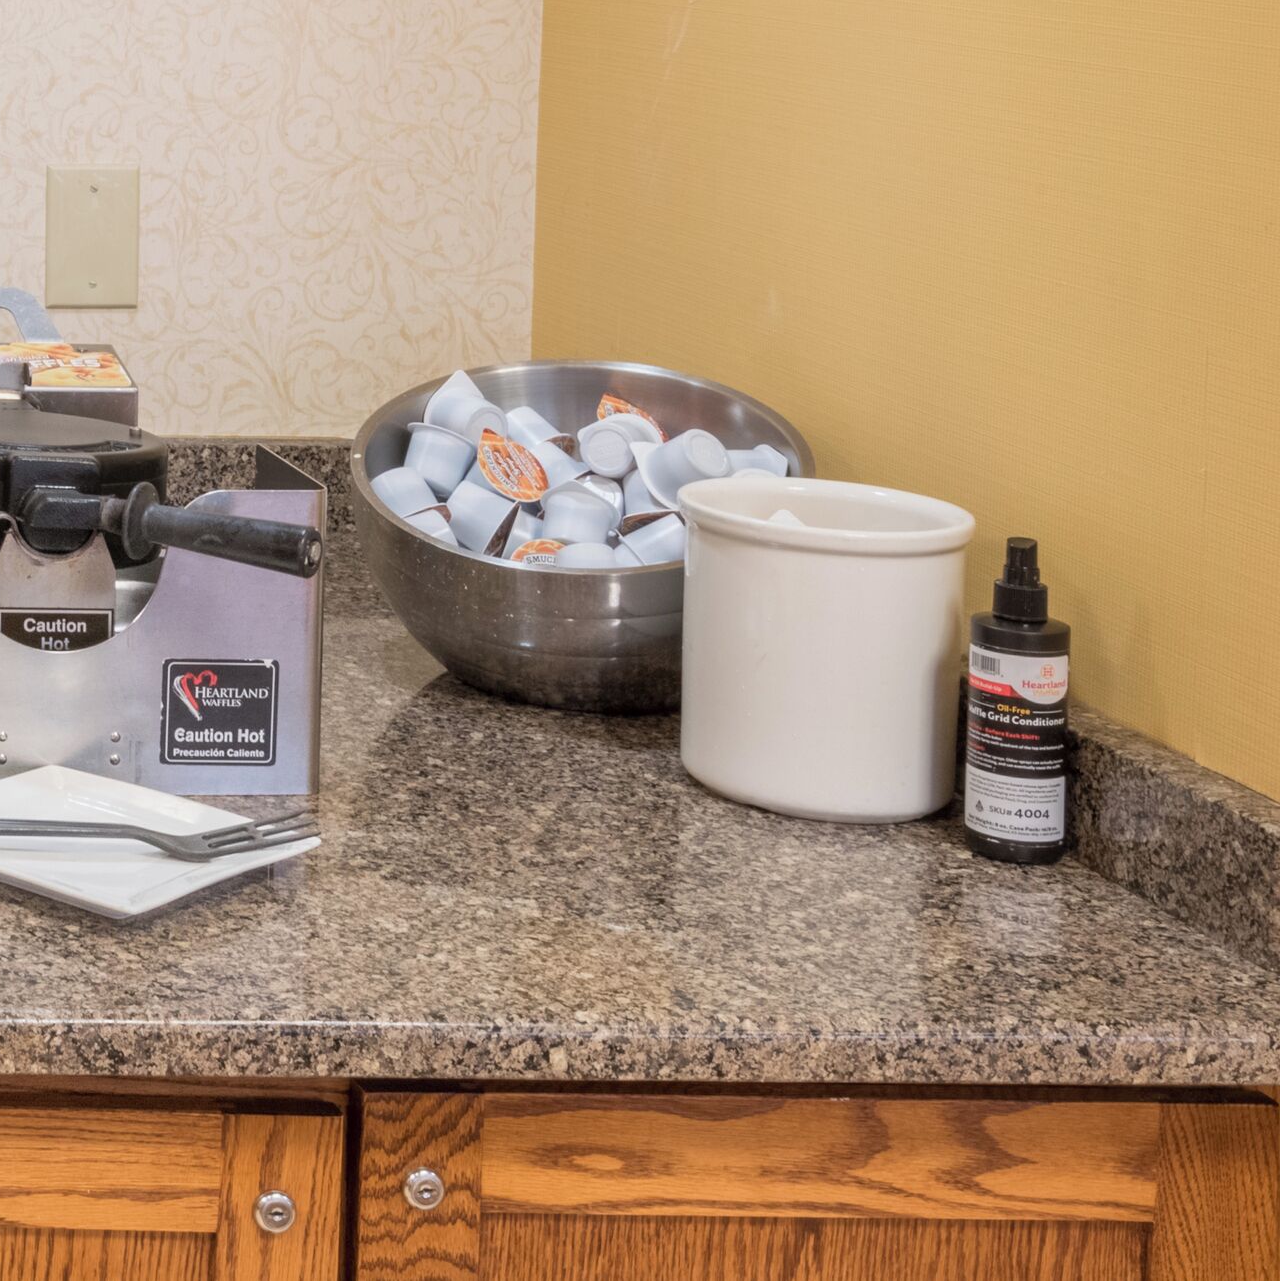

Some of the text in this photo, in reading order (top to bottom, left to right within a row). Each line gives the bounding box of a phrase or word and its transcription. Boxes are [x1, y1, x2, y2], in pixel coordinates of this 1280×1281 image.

[30, 359, 101, 368] FFLES
[24, 617, 87, 633] Caution
[41, 637, 70, 650] Hot
[1022, 680, 1066, 689] Heartland
[195, 686, 269, 699] HEARTLAND
[202, 698, 242, 707] WAFFLES
[996, 704, 1031, 714] Oil-Free
[987, 711, 1010, 724] Grid
[1011, 716, 1065, 726] Conditioner
[174, 727, 265, 743] Caution Hot
[173, 747, 265, 757] Precaución Caliente
[989, 805, 1050, 819] SKU# 4004
